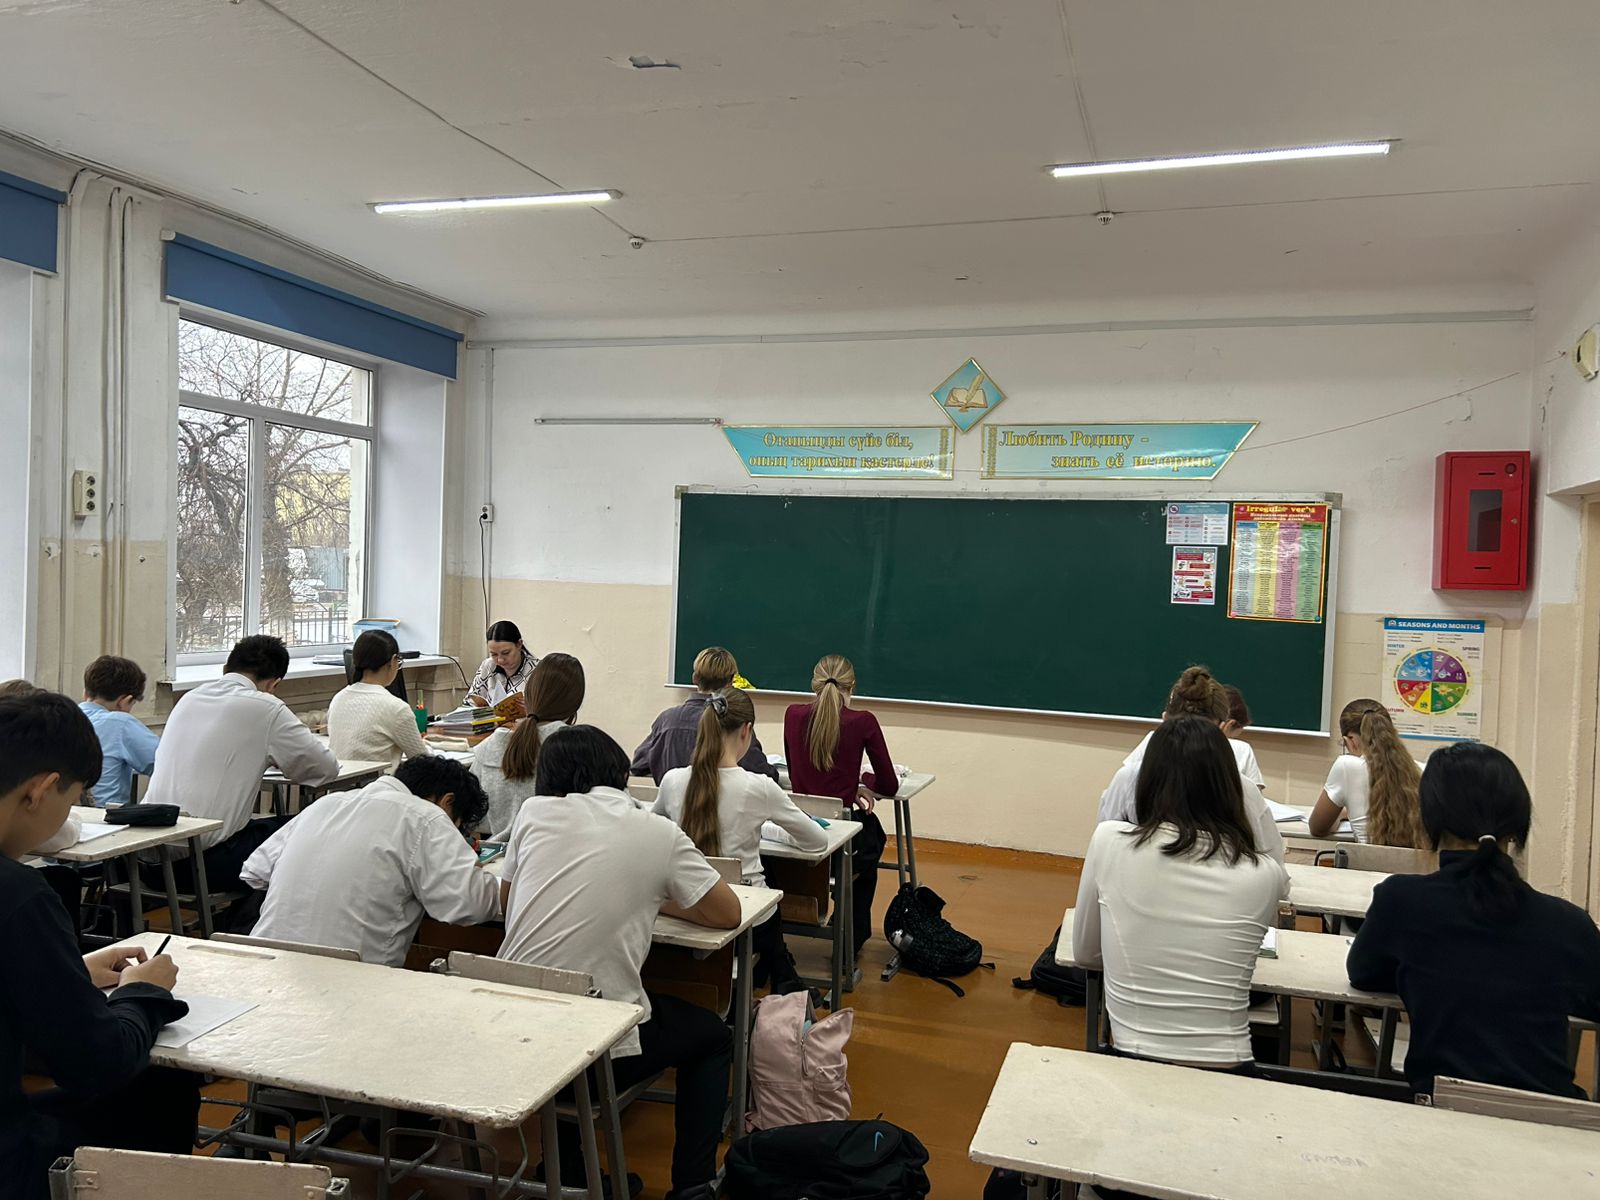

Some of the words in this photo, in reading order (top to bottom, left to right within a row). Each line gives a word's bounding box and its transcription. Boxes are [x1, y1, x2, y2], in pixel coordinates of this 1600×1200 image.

[999, 431, 1068, 447] Любить
[1070, 431, 1135, 450] Родину
[1051, 456, 1100, 468] знать
[1398, 621, 1431, 629] SEASONS
